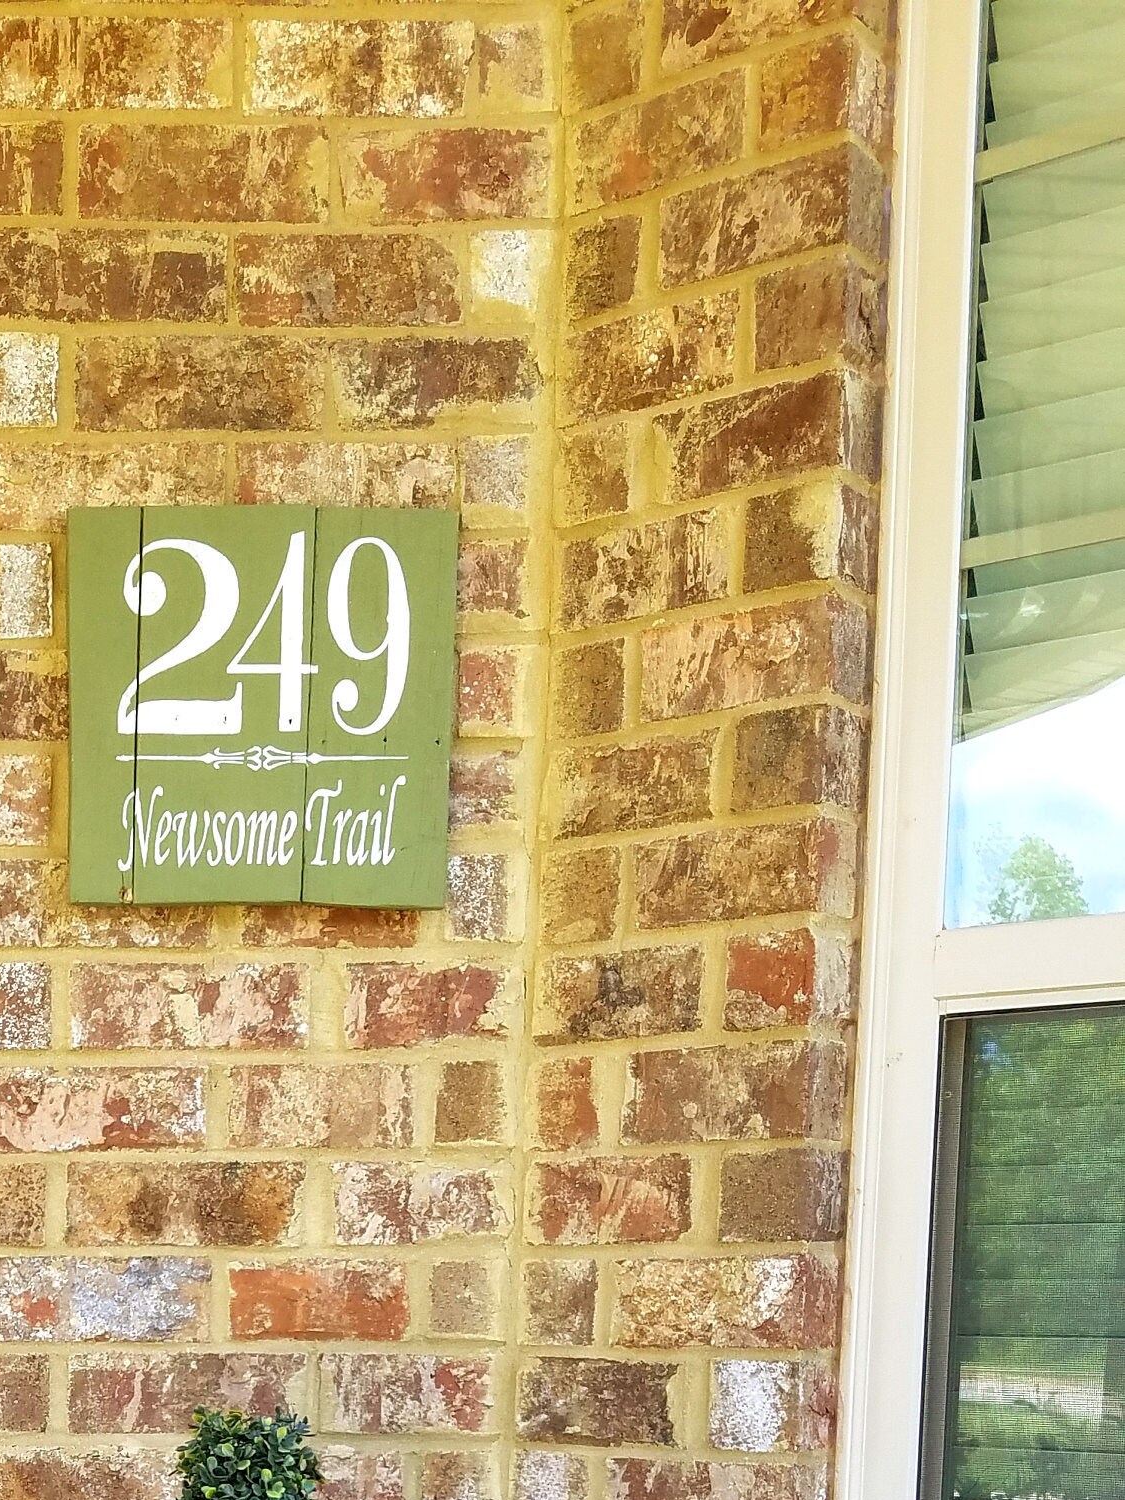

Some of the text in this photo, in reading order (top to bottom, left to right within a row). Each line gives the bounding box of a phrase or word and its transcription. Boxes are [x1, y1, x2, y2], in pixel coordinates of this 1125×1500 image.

[117, 530, 411, 736] 249
[117, 775, 407, 872] Newsome Trail
